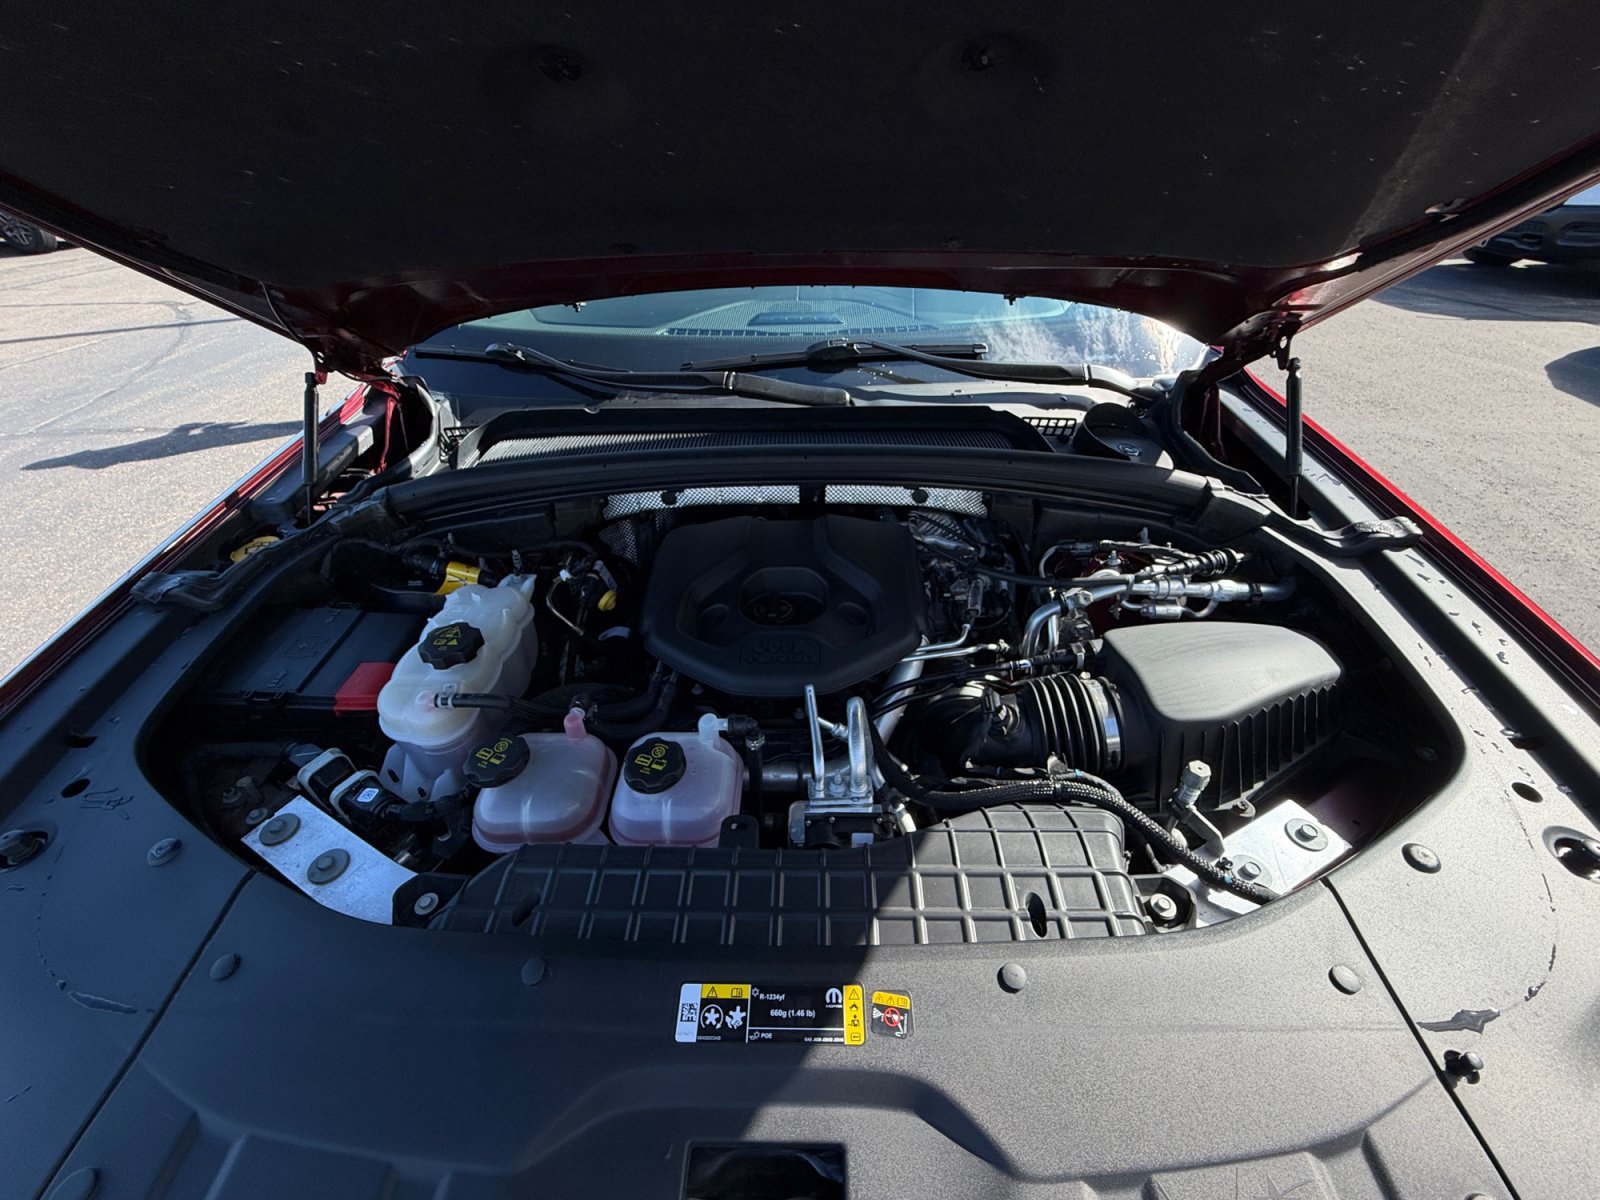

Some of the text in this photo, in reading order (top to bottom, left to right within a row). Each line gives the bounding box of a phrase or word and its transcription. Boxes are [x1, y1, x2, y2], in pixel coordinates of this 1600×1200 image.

[759, 993, 786, 1002] R-1234yf
[770, 1009, 816, 1018] 660g (1.46 lb)
